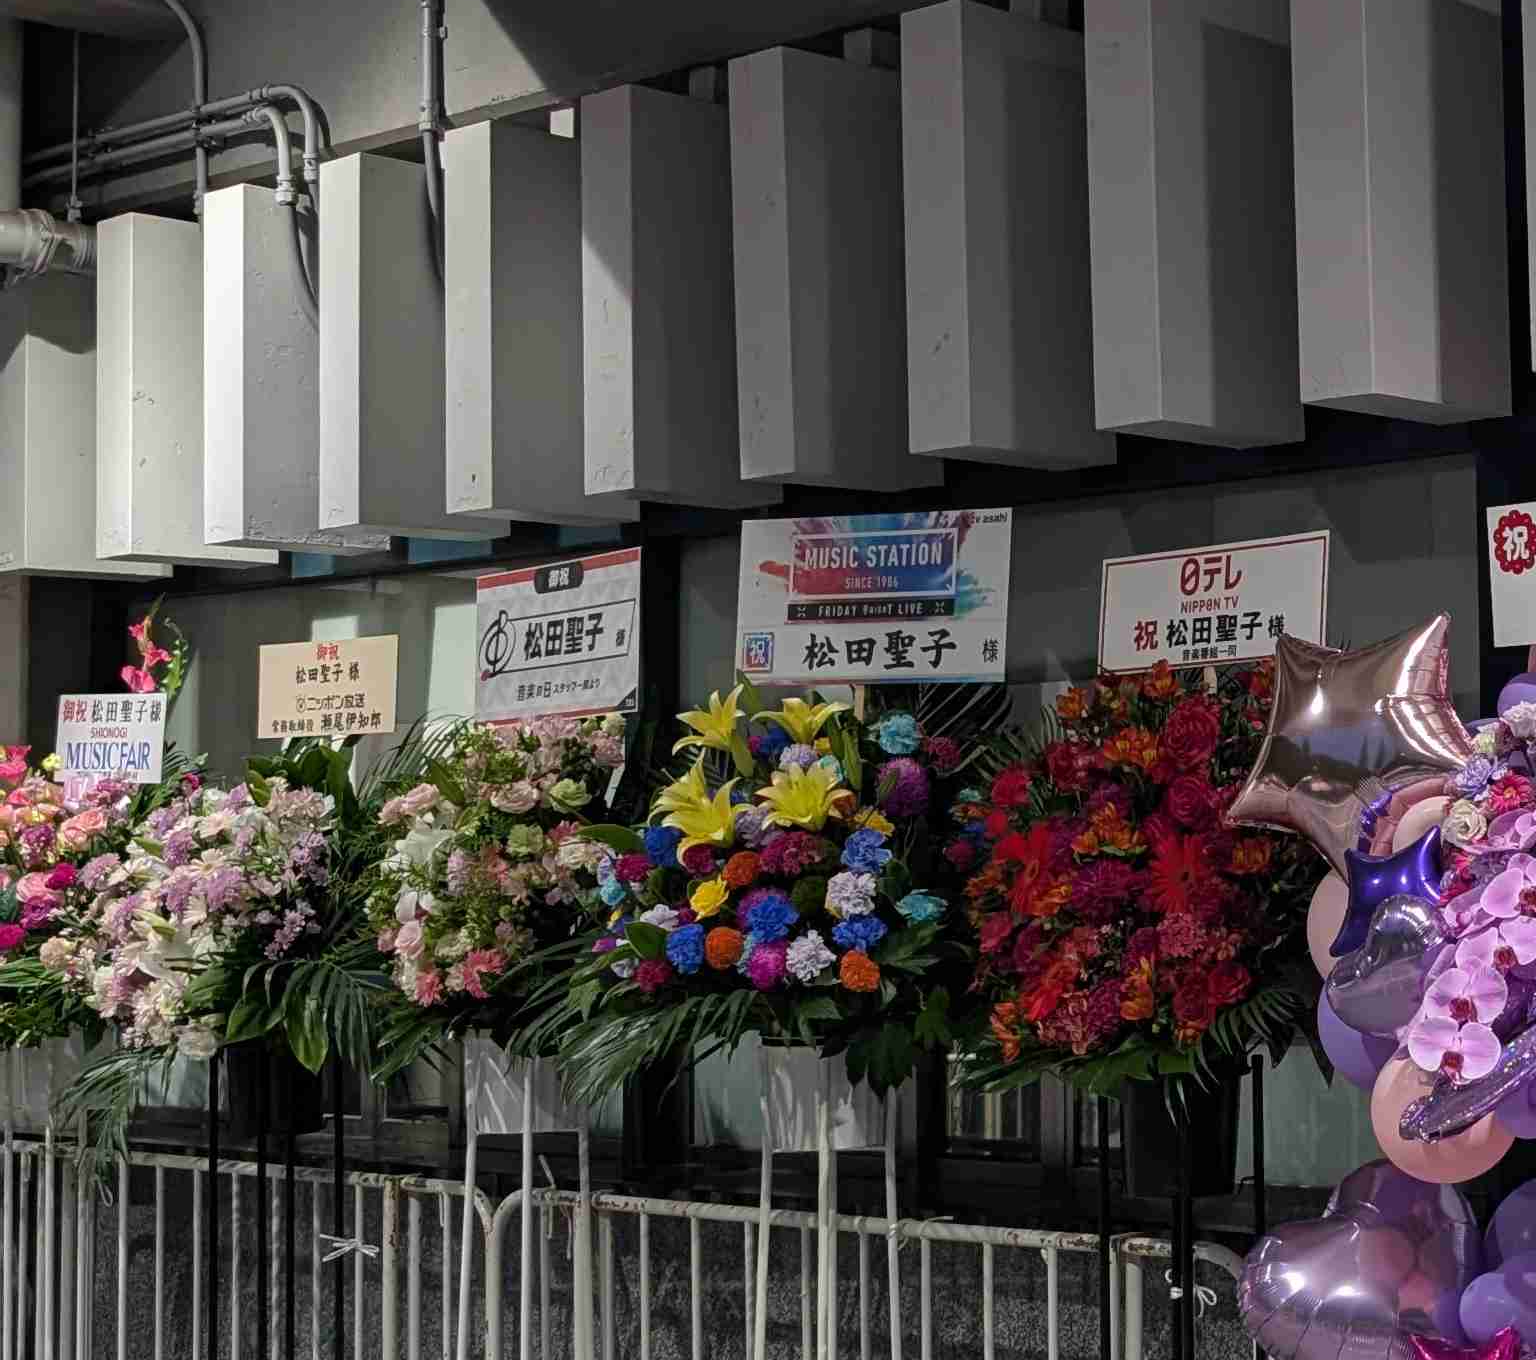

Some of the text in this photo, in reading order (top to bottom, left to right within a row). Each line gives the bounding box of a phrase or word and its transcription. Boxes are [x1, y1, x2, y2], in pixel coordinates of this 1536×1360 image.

[803, 542, 943, 571] MUSIC STATION
[1503, 524, 1530, 562] 祝
[844, 576, 873, 590] SINCE
[818, 604, 857, 618] FRIDAY
[897, 601, 924, 616] LIVE
[1222, 595, 1240, 610] TV
[523, 611, 605, 662] 松田聖子
[1134, 619, 1159, 652] 祝
[1165, 611, 1264, 649] 松田聖子
[802, 627, 957, 672] 松田聖子
[982, 637, 1002, 664] 様
[90, 726, 128, 739] SHIONOGI
